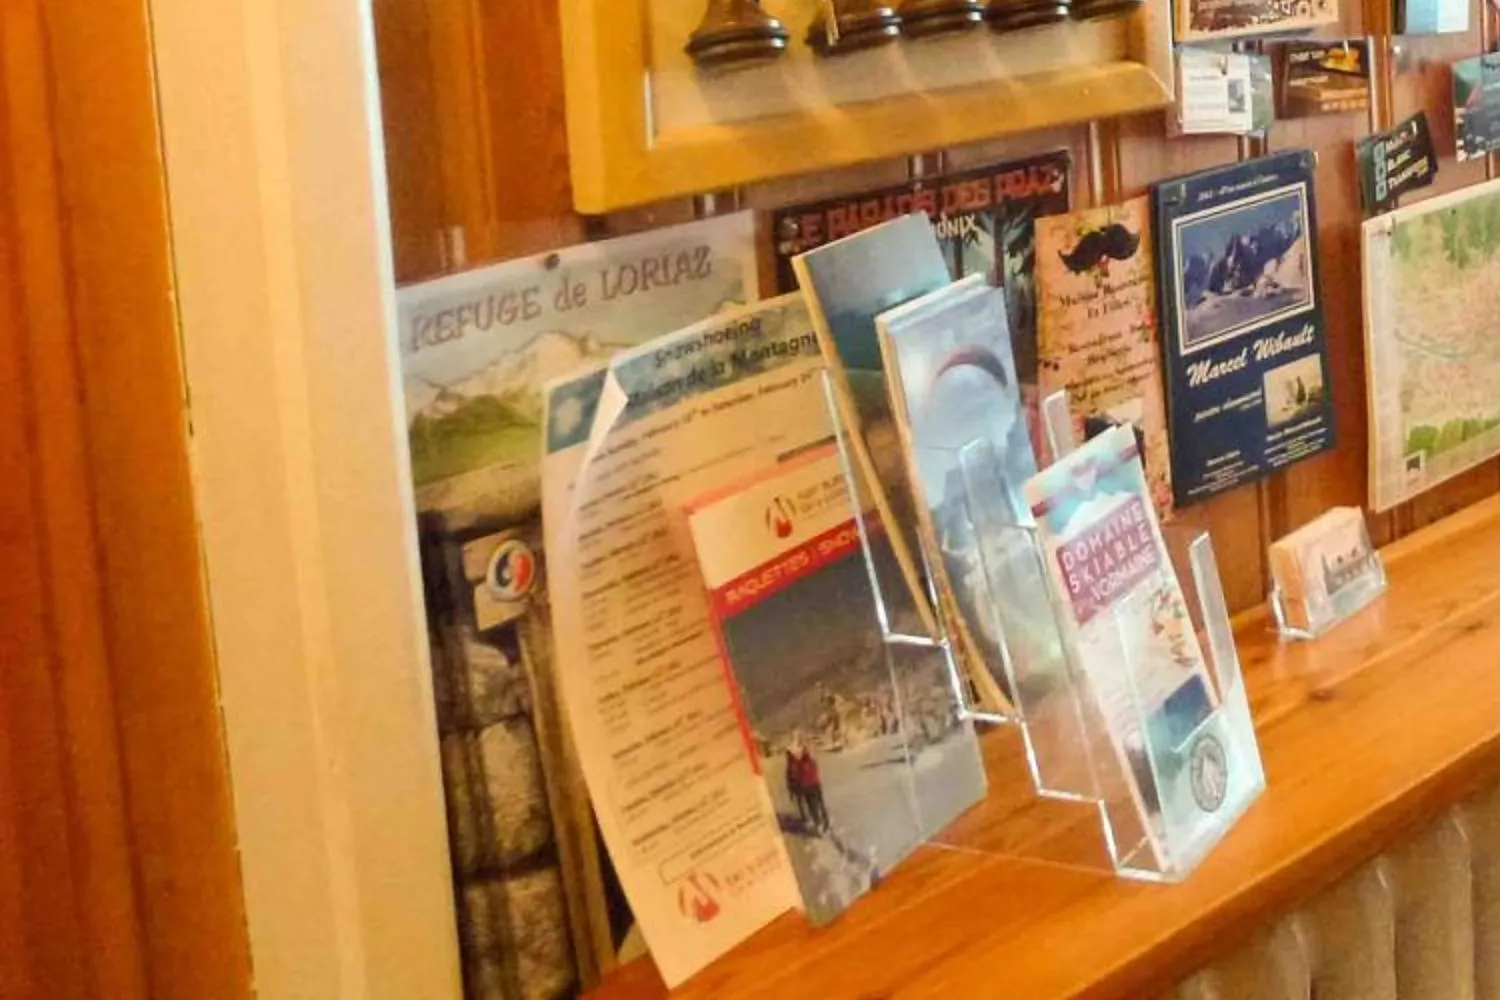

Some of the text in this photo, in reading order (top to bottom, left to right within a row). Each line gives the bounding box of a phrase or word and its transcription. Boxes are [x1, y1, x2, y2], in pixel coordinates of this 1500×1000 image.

[410, 244, 712, 351] REFUGE de LORIAZ
[1186, 346, 1248, 388] Marcel
[1252, 322, 1316, 361] Wibault
[1061, 502, 1145, 572] DOMAINE
[1068, 522, 1150, 595] SKIABLE
